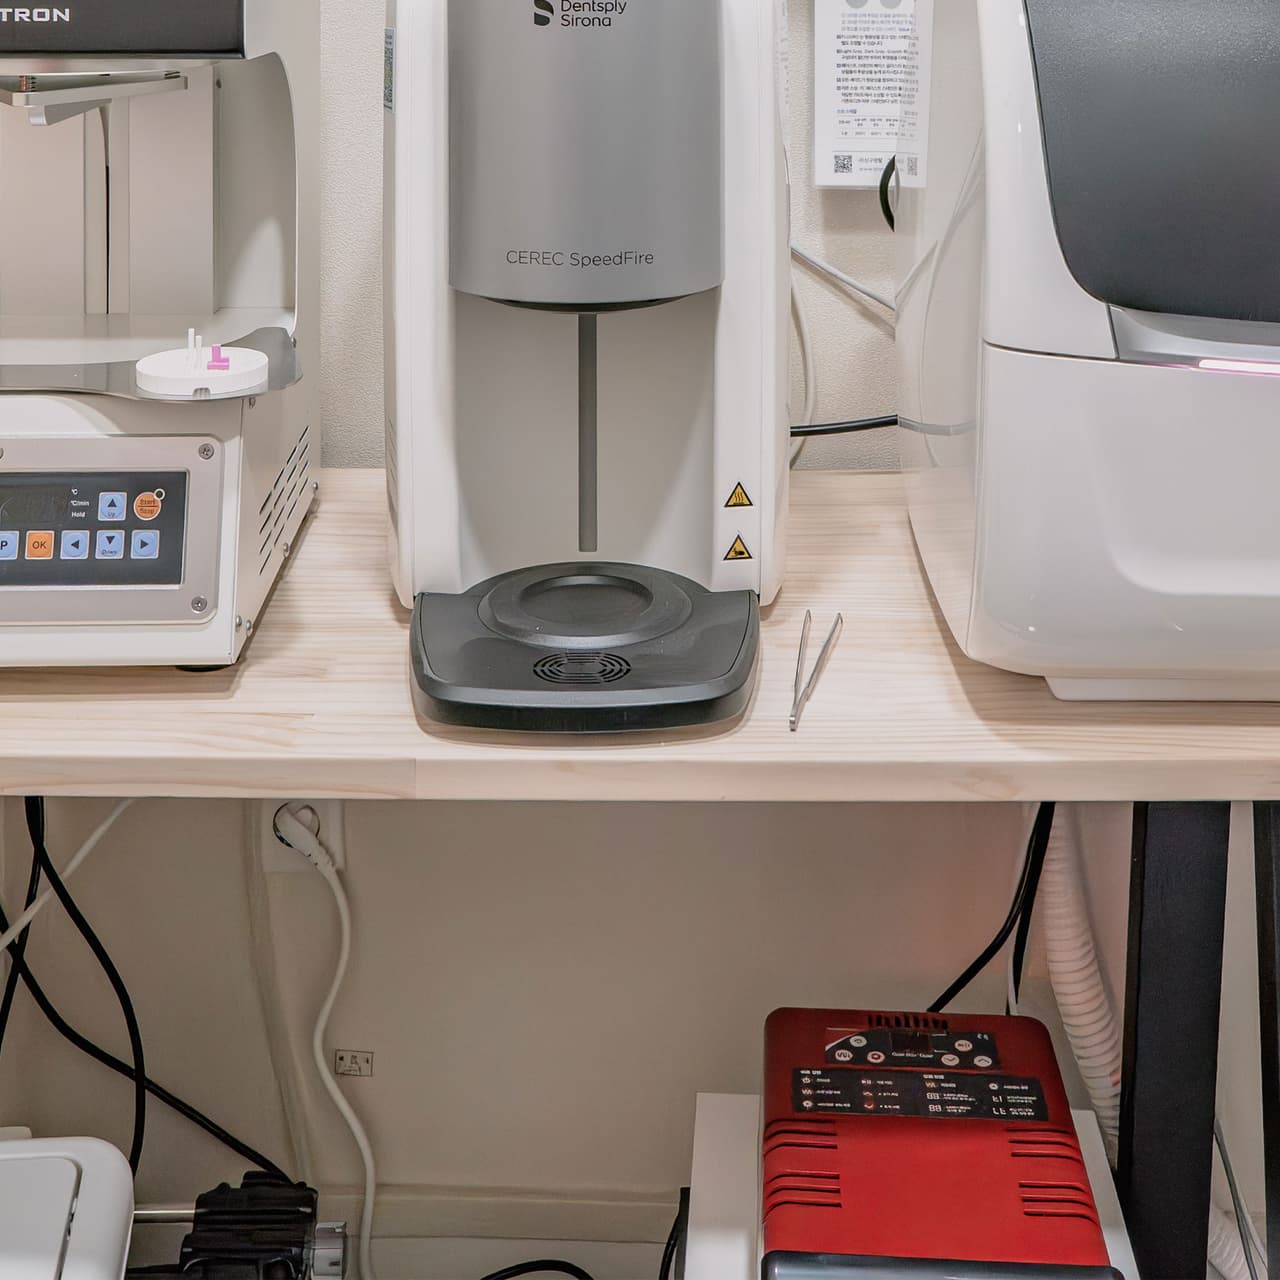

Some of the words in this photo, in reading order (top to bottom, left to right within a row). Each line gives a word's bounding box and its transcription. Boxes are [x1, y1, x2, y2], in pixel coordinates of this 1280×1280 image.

[560, 0, 627, 15] Dentsply
[560, 14, 612, 27] Sirona
[506, 250, 565, 266] CEREC
[569, 250, 654, 268] SpeedFire
[0, 540, 8, 550] P
[32, 540, 47, 549] OK
